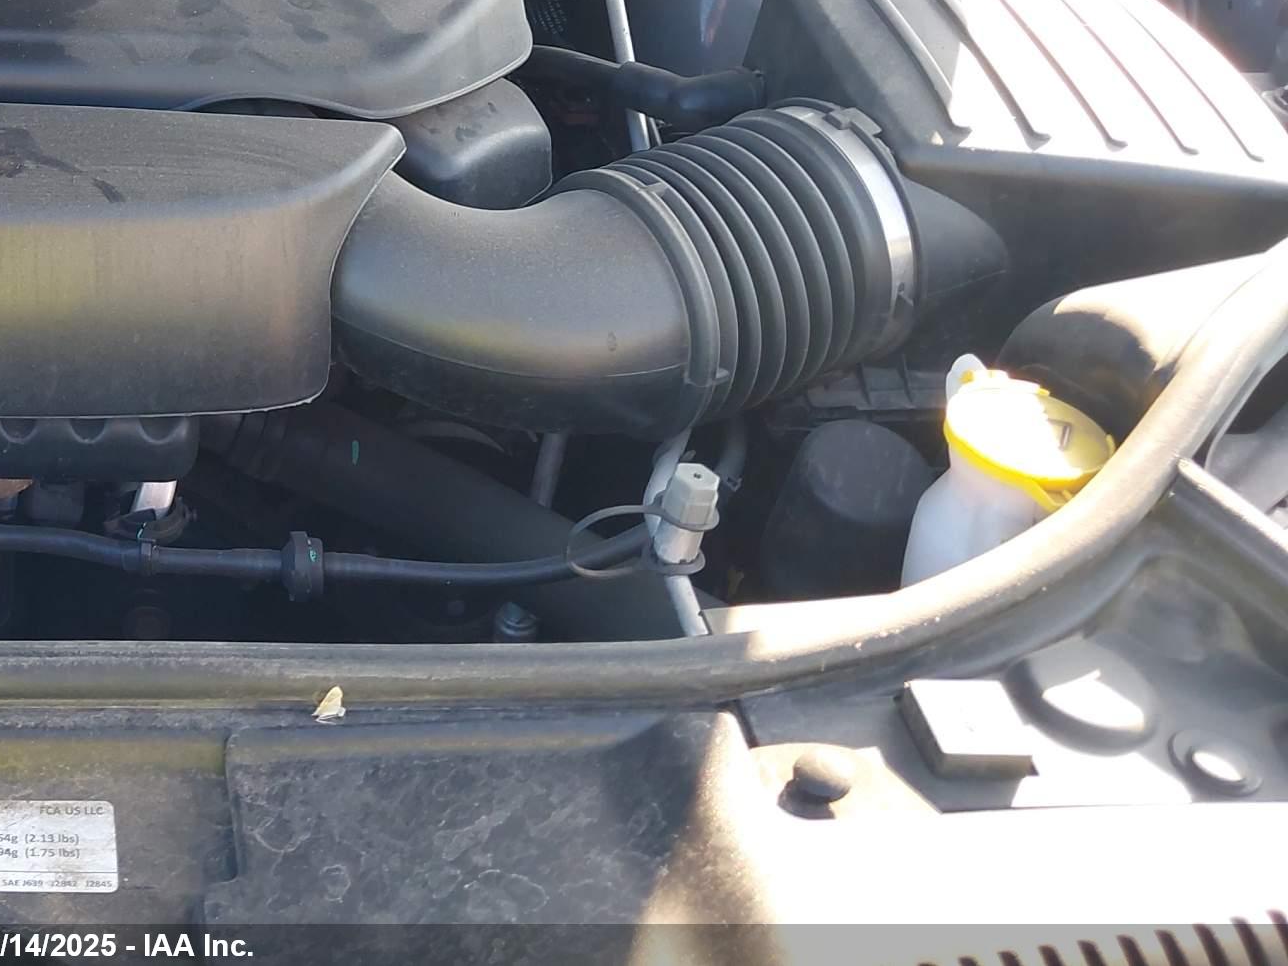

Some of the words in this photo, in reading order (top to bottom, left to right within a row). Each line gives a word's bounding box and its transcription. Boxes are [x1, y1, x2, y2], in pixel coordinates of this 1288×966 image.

[39, 805, 62, 815] FCA
[65, 806, 81, 815] US
[84, 806, 104, 815] LLC
[24, 833, 54, 845] (2.13
[58, 833, 80, 845] lbs)
[25, 847, 55, 859] (1.75
[58, 847, 81, 859] lbs)
